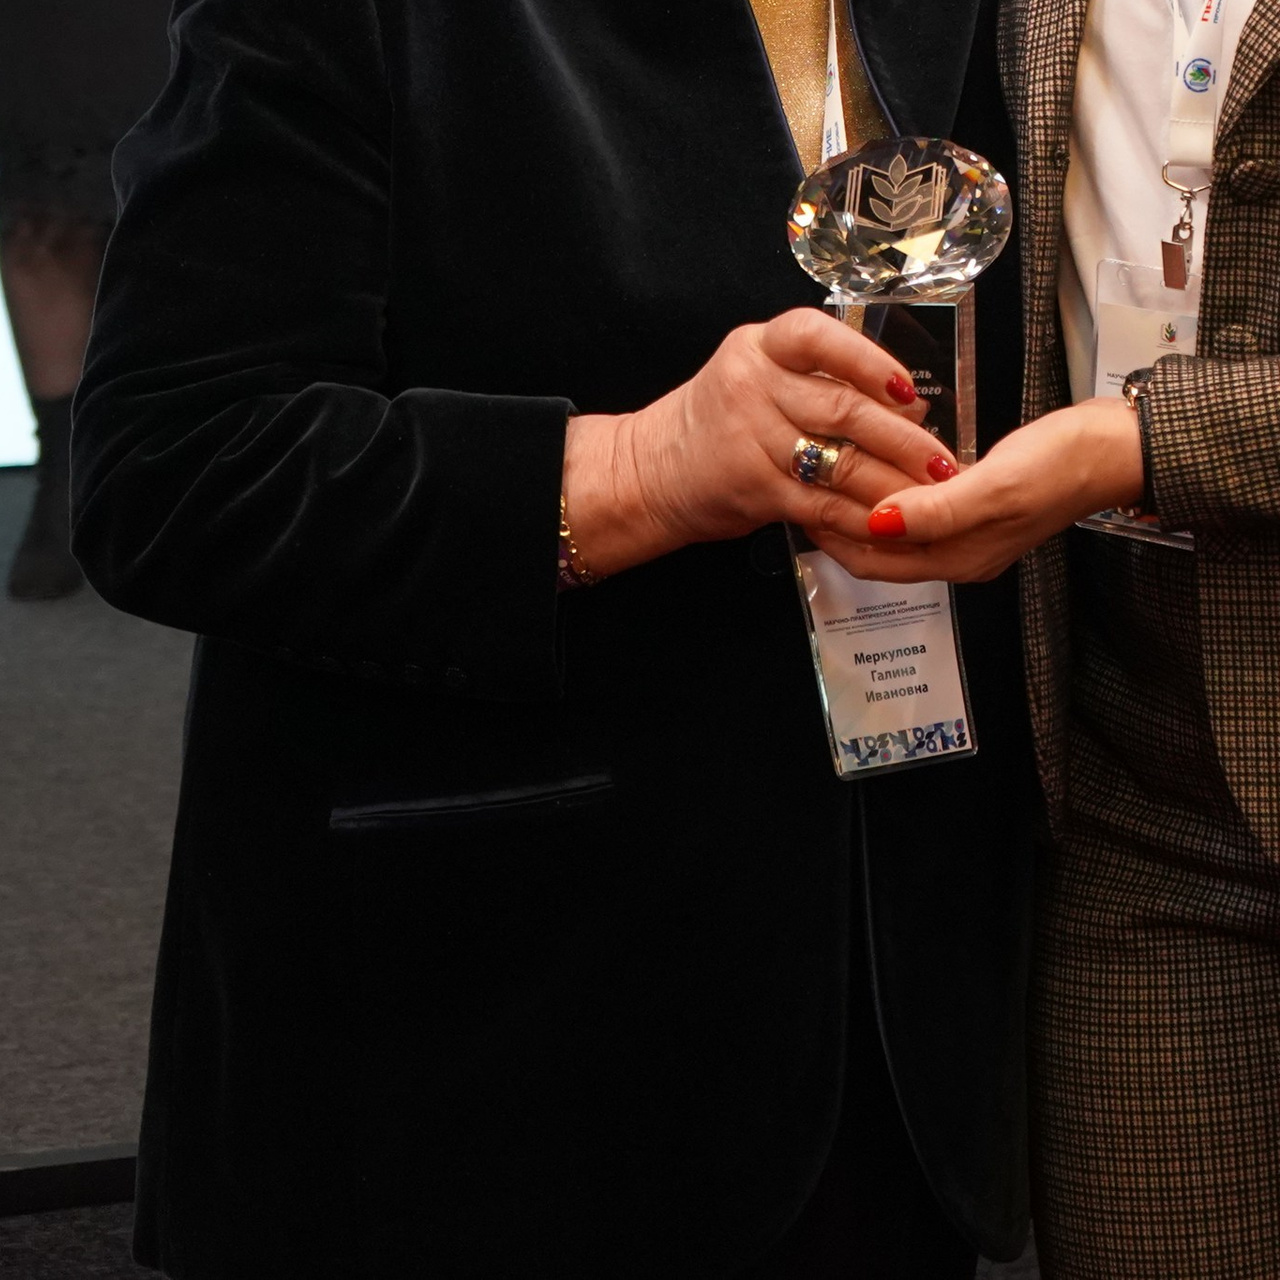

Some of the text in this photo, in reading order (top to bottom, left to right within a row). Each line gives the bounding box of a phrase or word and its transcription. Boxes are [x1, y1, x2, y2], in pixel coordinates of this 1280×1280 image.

[856, 600, 908, 614] ВСЕРОССИЙСКАЯ
[897, 602, 940, 614] КОНФЕРЕНЦИЯ
[854, 644, 926, 665] Меркулова
[871, 666, 916, 682] Галина
[865, 683, 929, 703] Ивановна
